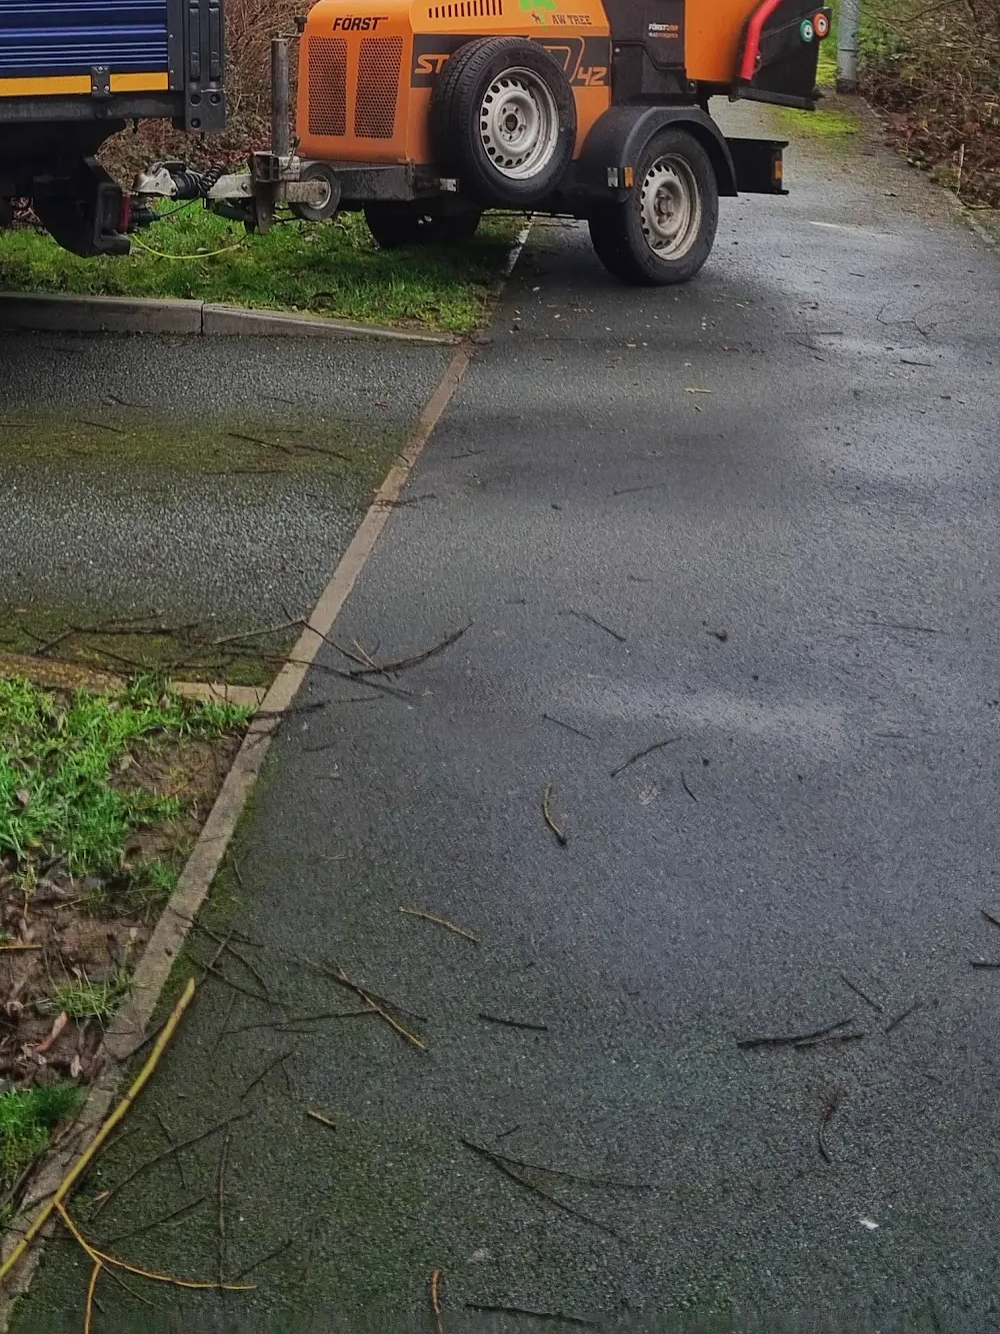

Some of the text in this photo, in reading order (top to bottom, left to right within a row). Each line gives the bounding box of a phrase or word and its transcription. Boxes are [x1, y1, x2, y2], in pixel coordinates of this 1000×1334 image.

[333, 15, 388, 32] FÖRST
[551, 14, 593, 26] AW TREE
[577, 66, 607, 87] 42
